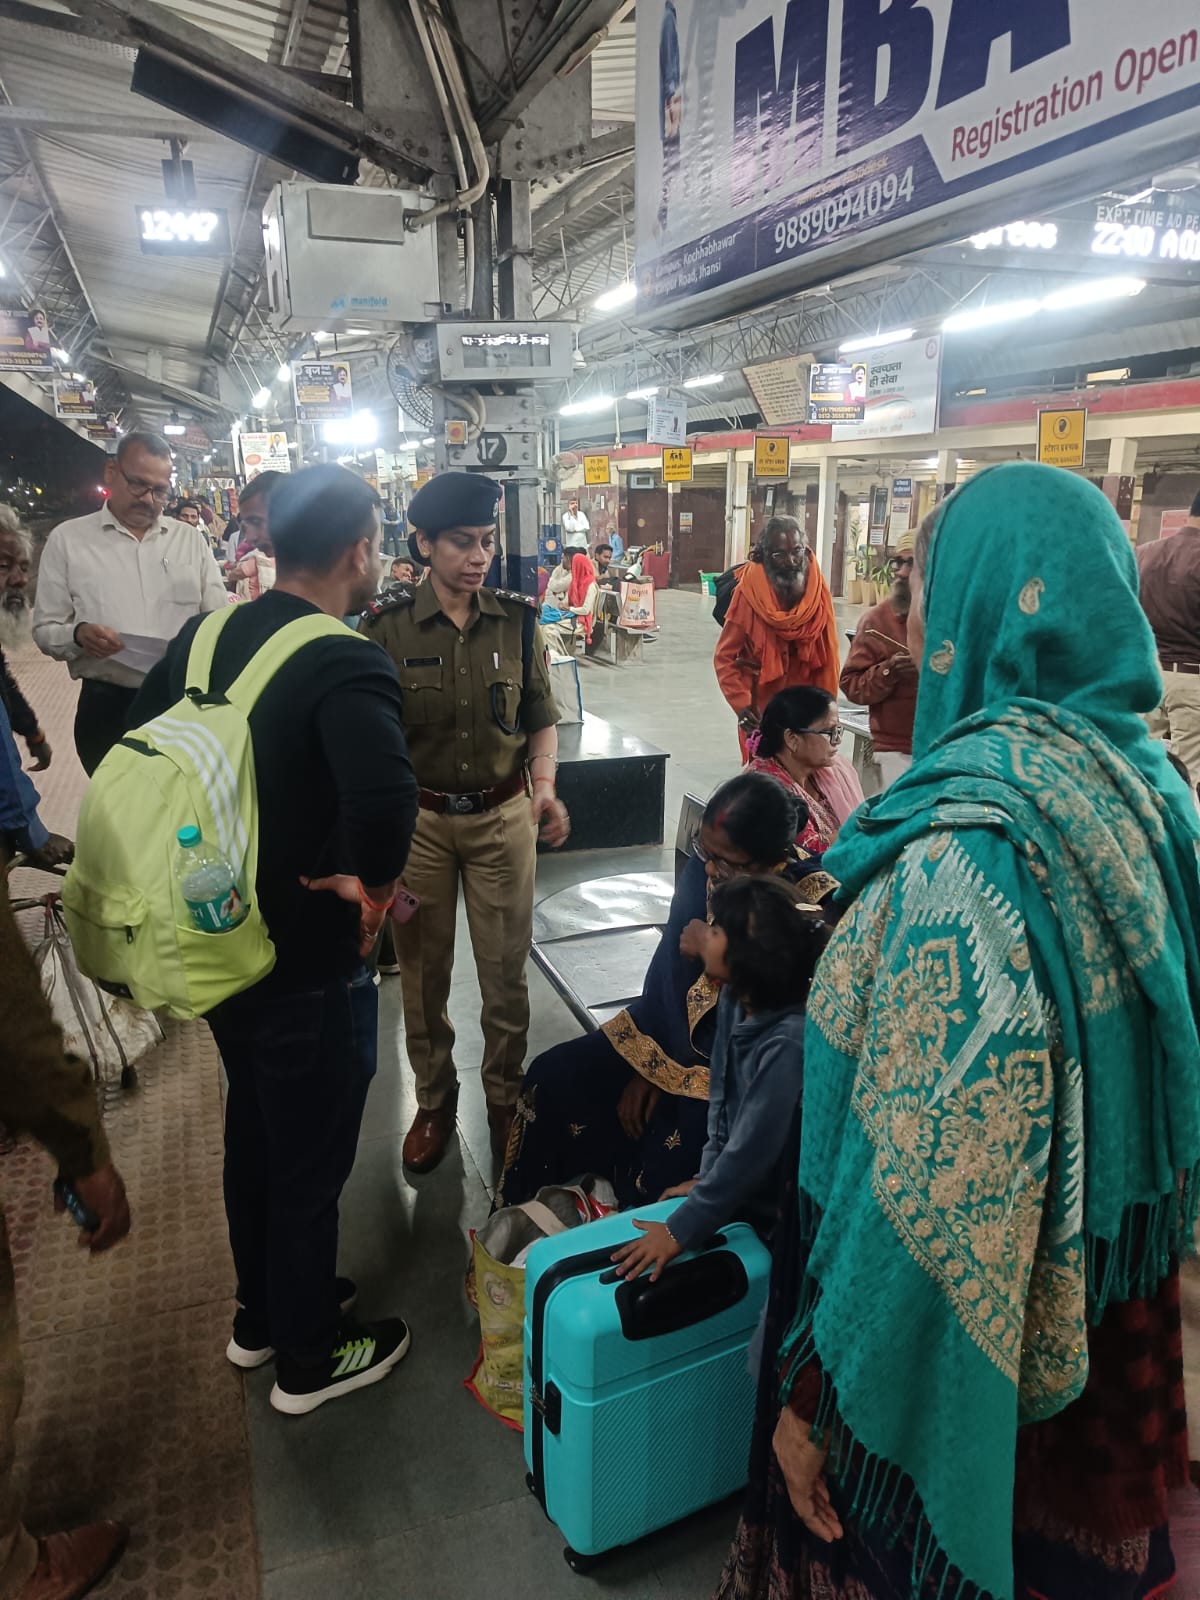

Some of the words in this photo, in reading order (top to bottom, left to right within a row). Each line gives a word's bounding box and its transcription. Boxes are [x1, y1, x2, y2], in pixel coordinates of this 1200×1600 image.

[951, 71, 1103, 162] Registration
[1114, 28, 1199, 95] Open
[774, 165, 915, 254] 9889094094
[1133, 208, 1164, 227] TIME
[678, 269, 698, 288] Road,
[698, 258, 721, 279] Jhansi
[880, 373, 898, 385] सेवा
[480, 437, 500, 461] 17
